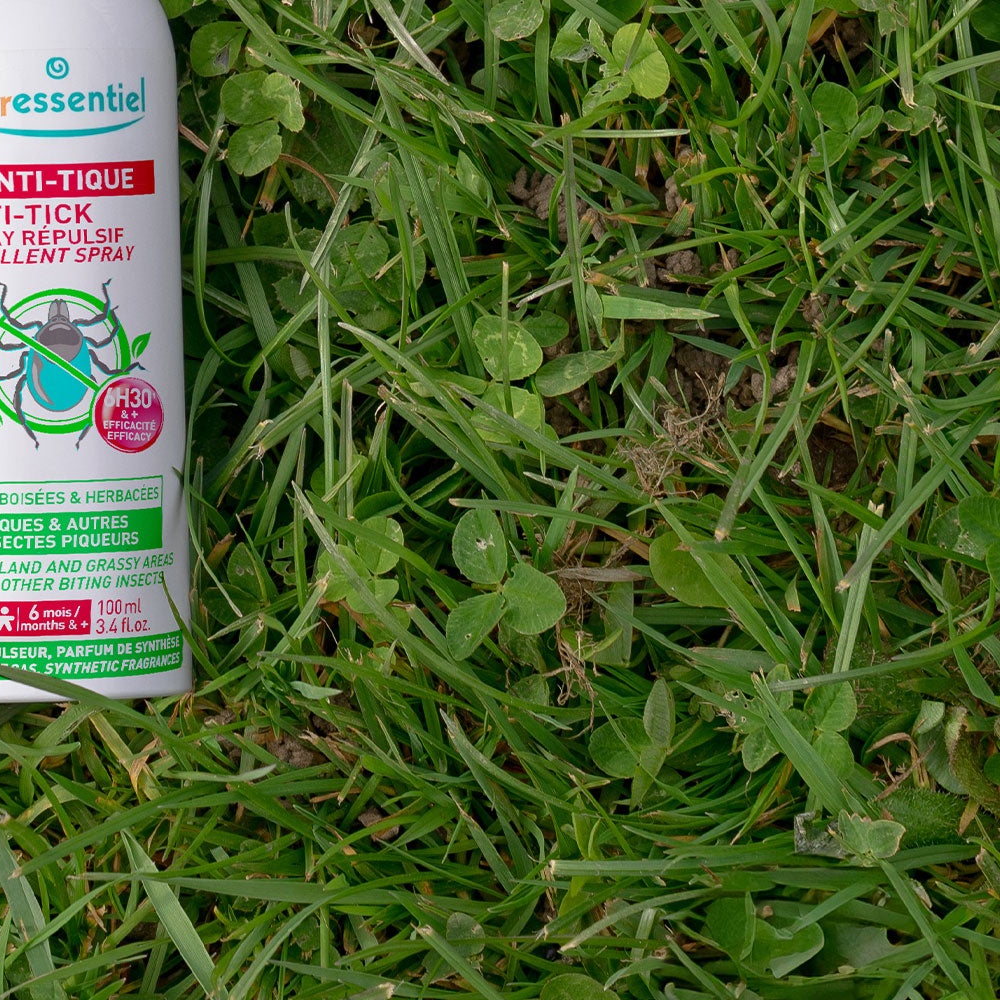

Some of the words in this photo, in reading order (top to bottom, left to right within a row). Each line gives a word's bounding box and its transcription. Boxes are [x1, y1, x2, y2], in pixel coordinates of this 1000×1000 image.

[22, 225, 124, 246] RÉPULSIF
[74, 245, 135, 262] SPRAY
[121, 409, 129, 419] &
[103, 419, 156, 431] EFFICACITÉ
[107, 431, 151, 441] EFFICACY
[0, 488, 65, 505] BOISÉES
[70, 491, 81, 504] &
[85, 484, 159, 504] HERBACÉES
[48, 517, 61, 531] &
[66, 515, 129, 530] AUTRES
[61, 531, 139, 547] PIQUEURS
[45, 560, 82, 573] AND
[86, 556, 141, 572] GRASSY
[142, 552, 174, 569] AREAS
[1, 577, 55, 591] OTHER
[58, 575, 112, 591] BITING
[115, 571, 164, 588] INSECTS
[28, 604, 40, 620] 6
[97, 599, 122, 616] 100
[124, 598, 141, 615] ml
[20, 619, 65, 631] months
[68, 619, 77, 630] &
[95, 617, 118, 634] 3.4
[56, 644, 114, 658] PARFUM
[117, 643, 133, 655] DE
[135, 634, 180, 654] SYNTHÈSE
[43, 660, 120, 675] SYNTHETIC
[120, 651, 180, 671] FRAGRANCES
